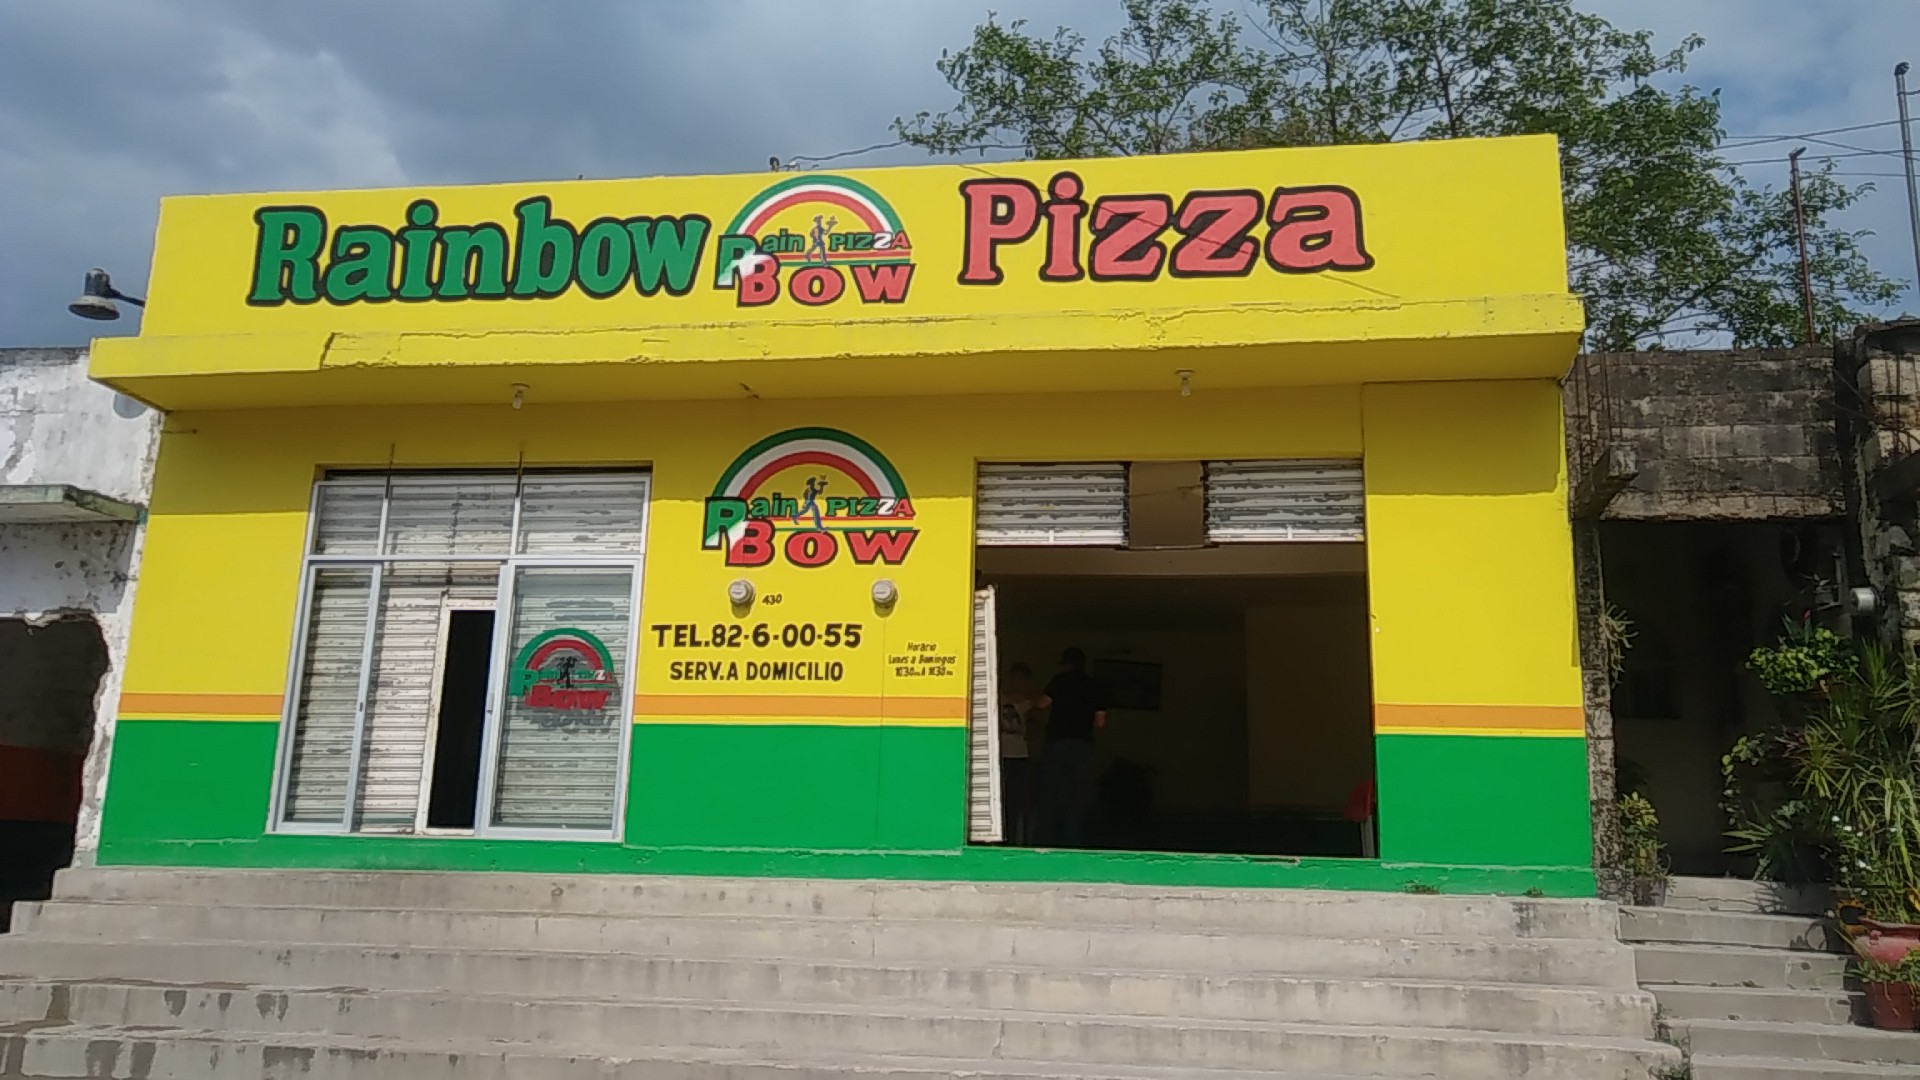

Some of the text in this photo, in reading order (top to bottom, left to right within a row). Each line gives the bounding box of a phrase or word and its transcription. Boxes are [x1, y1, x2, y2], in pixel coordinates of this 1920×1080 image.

[246, 195, 711, 305] Rainbow
[957, 171, 1375, 285] Pizza
[713, 228, 912, 290] Rain PIZZA
[736, 252, 916, 307] BOW
[701, 491, 916, 550] Rain PIZZA
[725, 517, 920, 567] BOW
[746, 661, 844, 682] DOMICILIO
